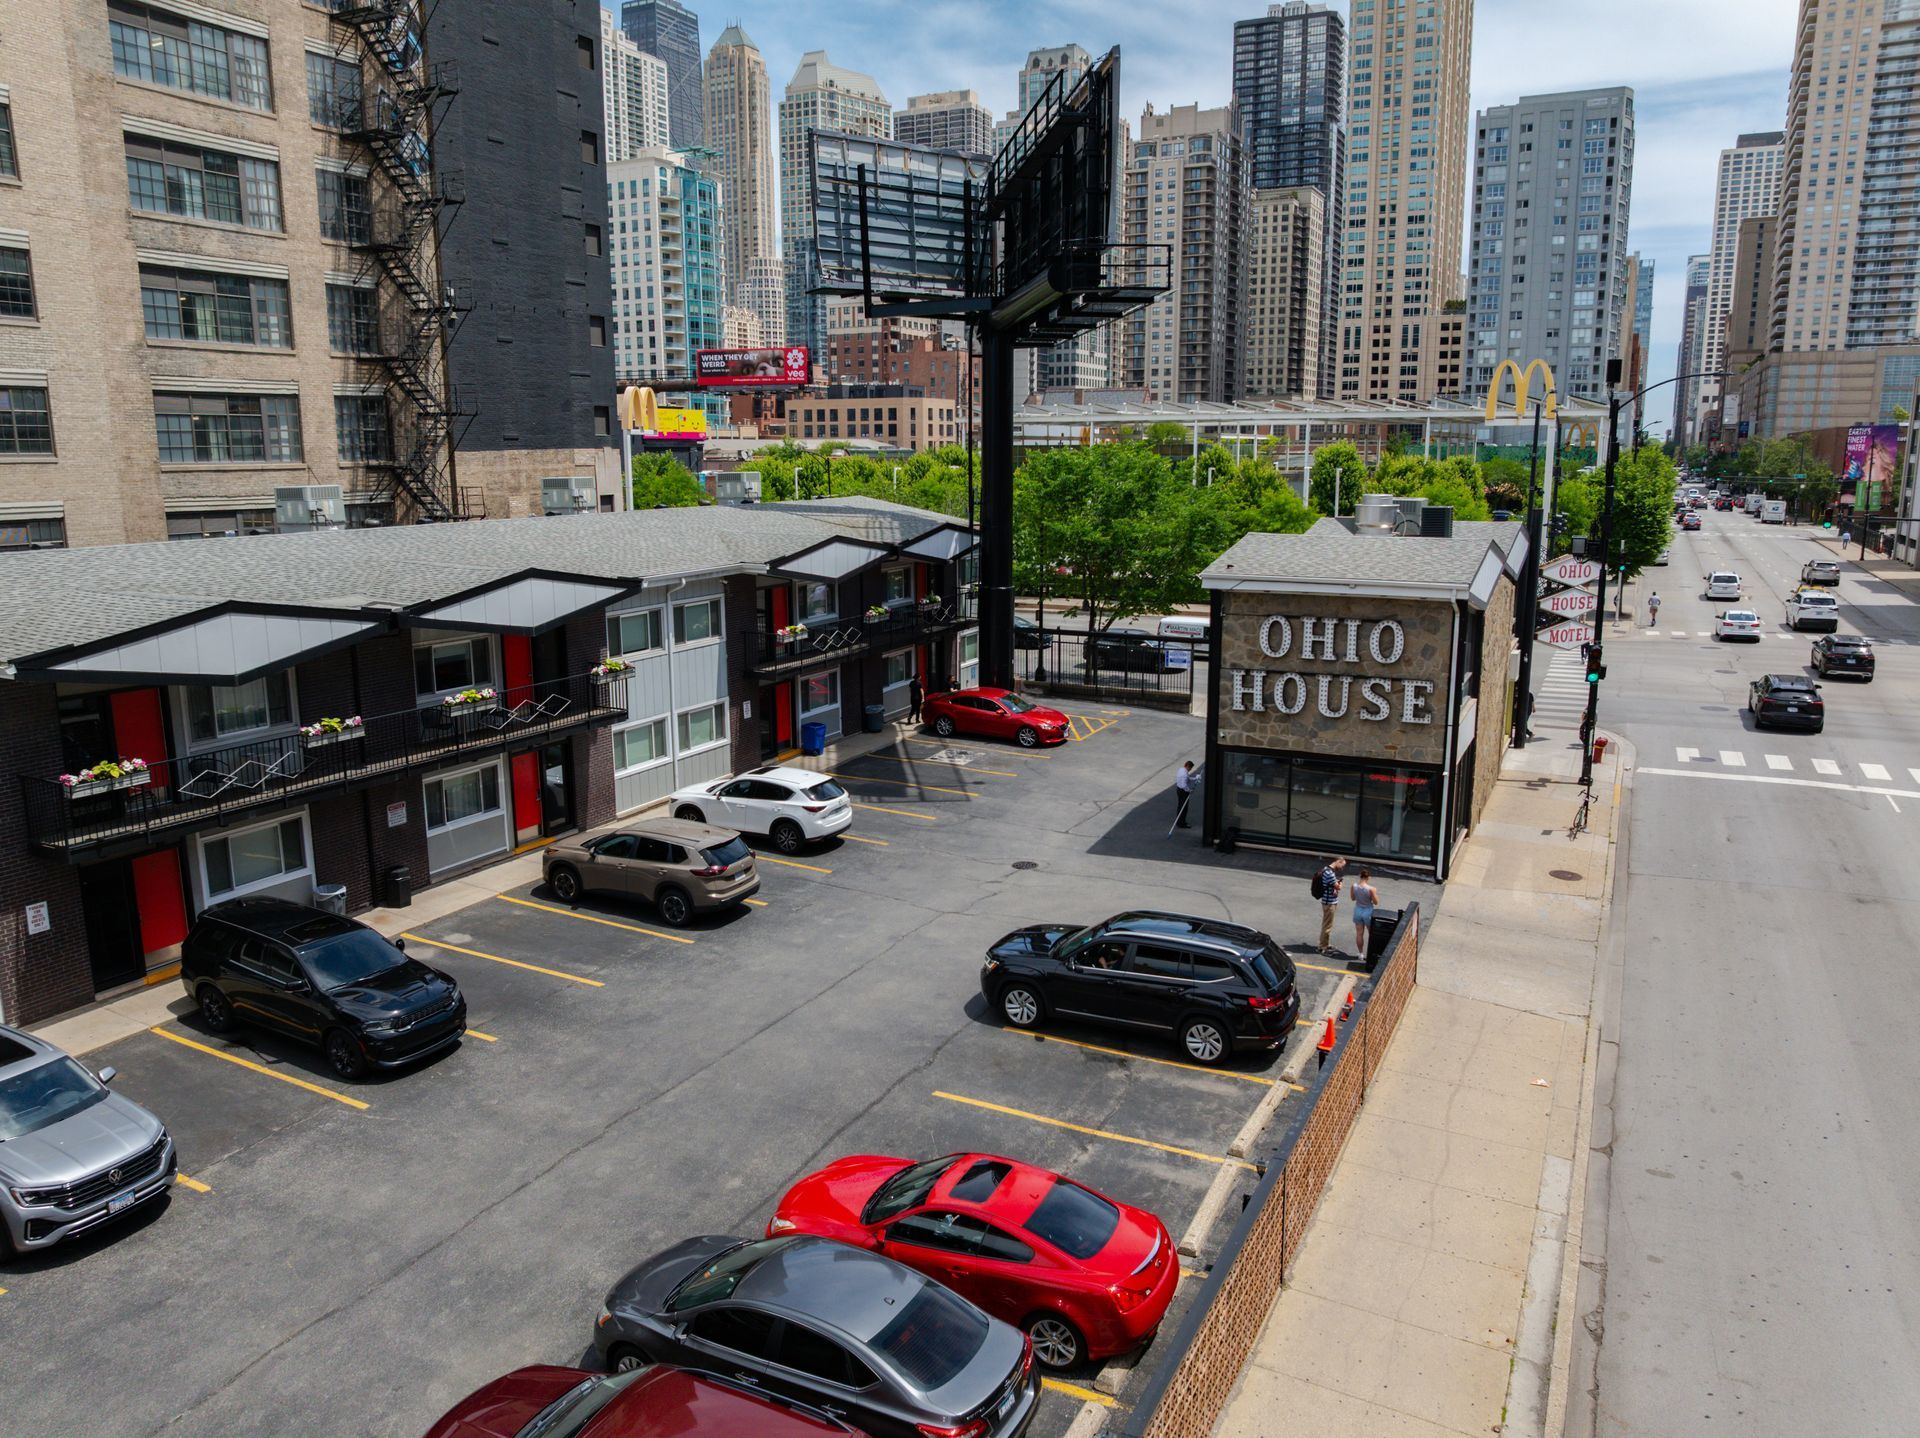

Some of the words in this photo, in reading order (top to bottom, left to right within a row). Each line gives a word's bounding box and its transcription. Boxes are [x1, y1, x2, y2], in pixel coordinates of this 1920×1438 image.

[1848, 427, 1872, 436] EARTH'S
[1559, 564, 1592, 579] OHIO
[1551, 596, 1594, 611] HOUSE
[1258, 614, 1406, 665] OHIO
[1549, 627, 1590, 643] MOTEL
[1231, 669, 1435, 725] HOUSE
